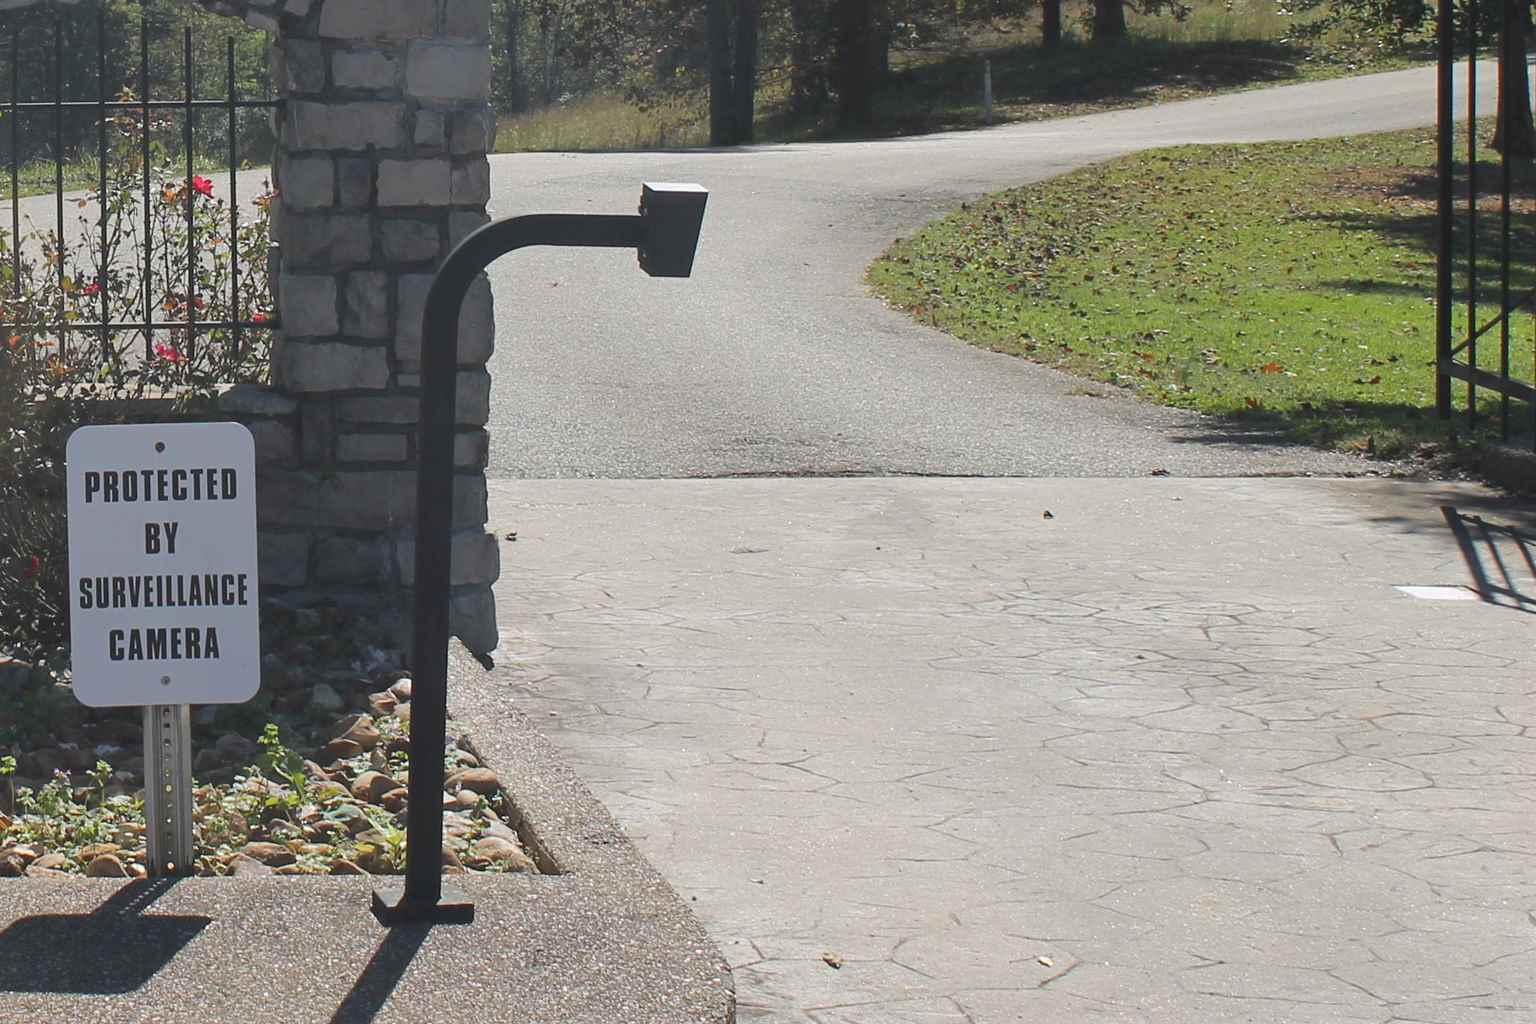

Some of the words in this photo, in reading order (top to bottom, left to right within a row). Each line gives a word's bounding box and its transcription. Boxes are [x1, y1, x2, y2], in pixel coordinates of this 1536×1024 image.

[85, 468, 238, 503] PROTECTED
[145, 522, 178, 554] BY
[79, 574, 248, 609] SURVEILLANCE
[109, 627, 220, 661] CAMERA
